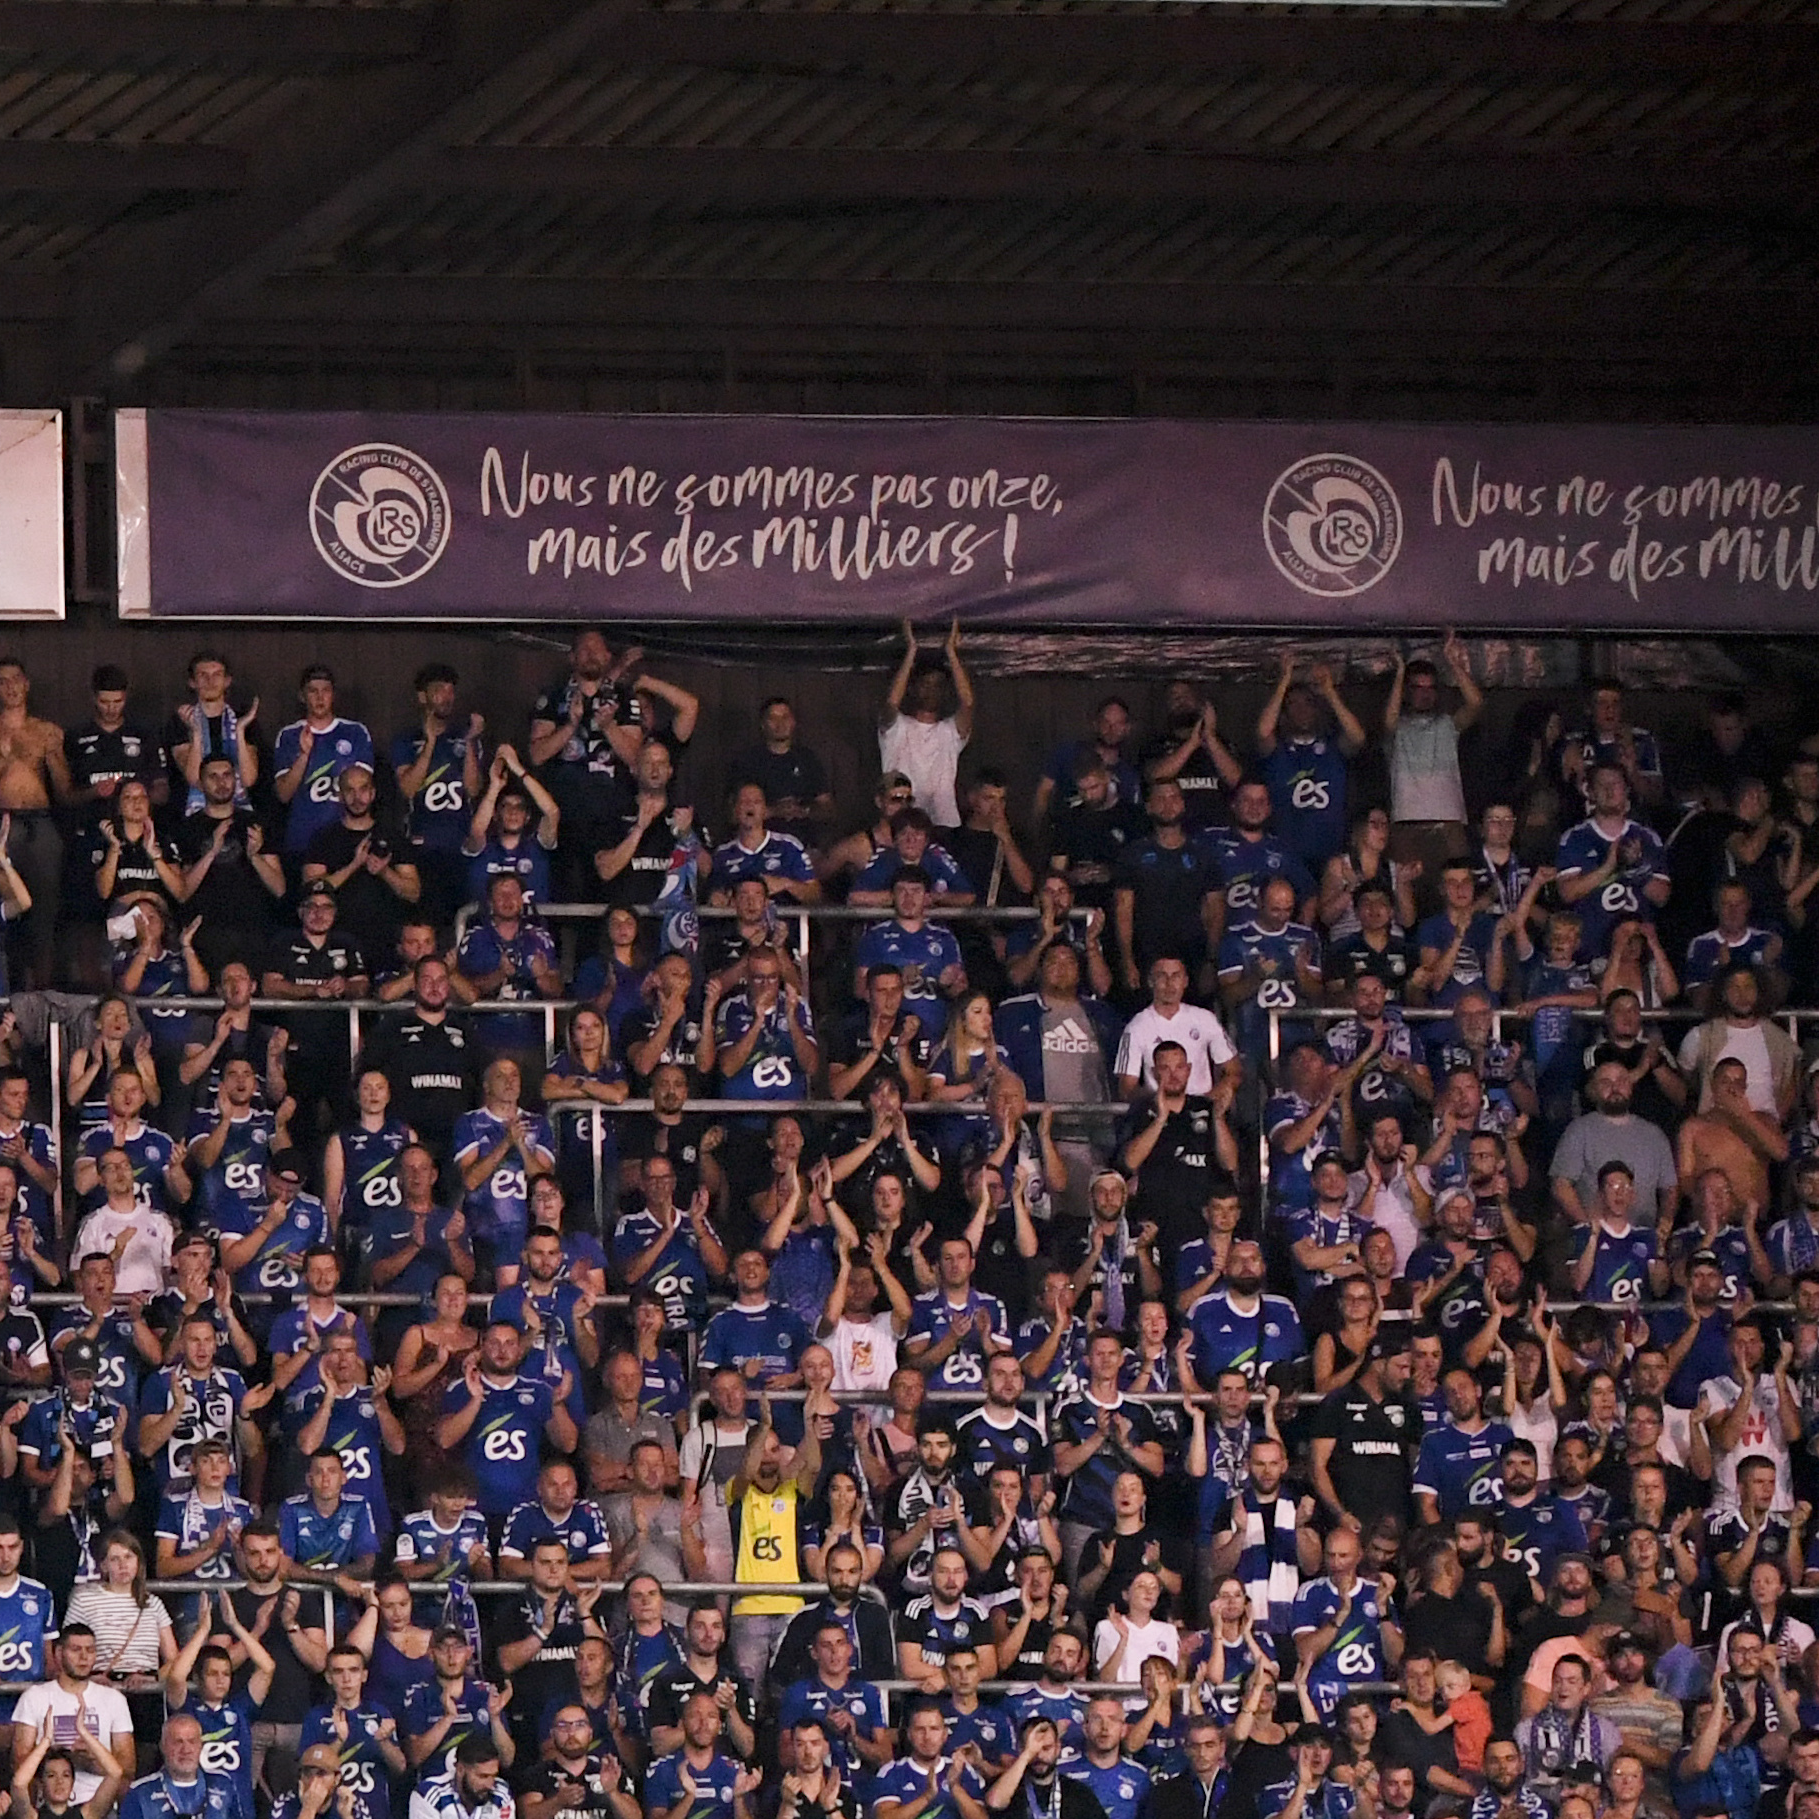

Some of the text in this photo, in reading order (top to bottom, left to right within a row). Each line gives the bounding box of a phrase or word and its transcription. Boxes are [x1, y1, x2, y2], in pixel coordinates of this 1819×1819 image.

[338, 453, 379, 474] RACING
[380, 454, 409, 471] CLUB
[480, 446, 1066, 529] Nous ne sommes pas onze,
[1432, 456, 1803, 529] Nous ne sommes
[328, 541, 367, 575] ALSACE
[527, 525, 651, 580] mais
[660, 514, 739, 592] des
[752, 515, 995, 582] Milliers
[1478, 535, 1599, 586] mais
[1608, 521, 1690, 601] des
[310, 772, 340, 803] es
[424, 779, 463, 811] es
[1291, 775, 1329, 810] es
[1257, 978, 1296, 1007] es
[752, 1056, 791, 1087] es
[225, 1159, 262, 1189] es
[363, 1176, 402, 1207] es
[483, 1428, 526, 1461] es
[1352, 1442, 1399, 1455] WINAMA
[752, 1536, 782, 1562] es
[1337, 1643, 1375, 1675] es
[199, 1740, 239, 1770] es
